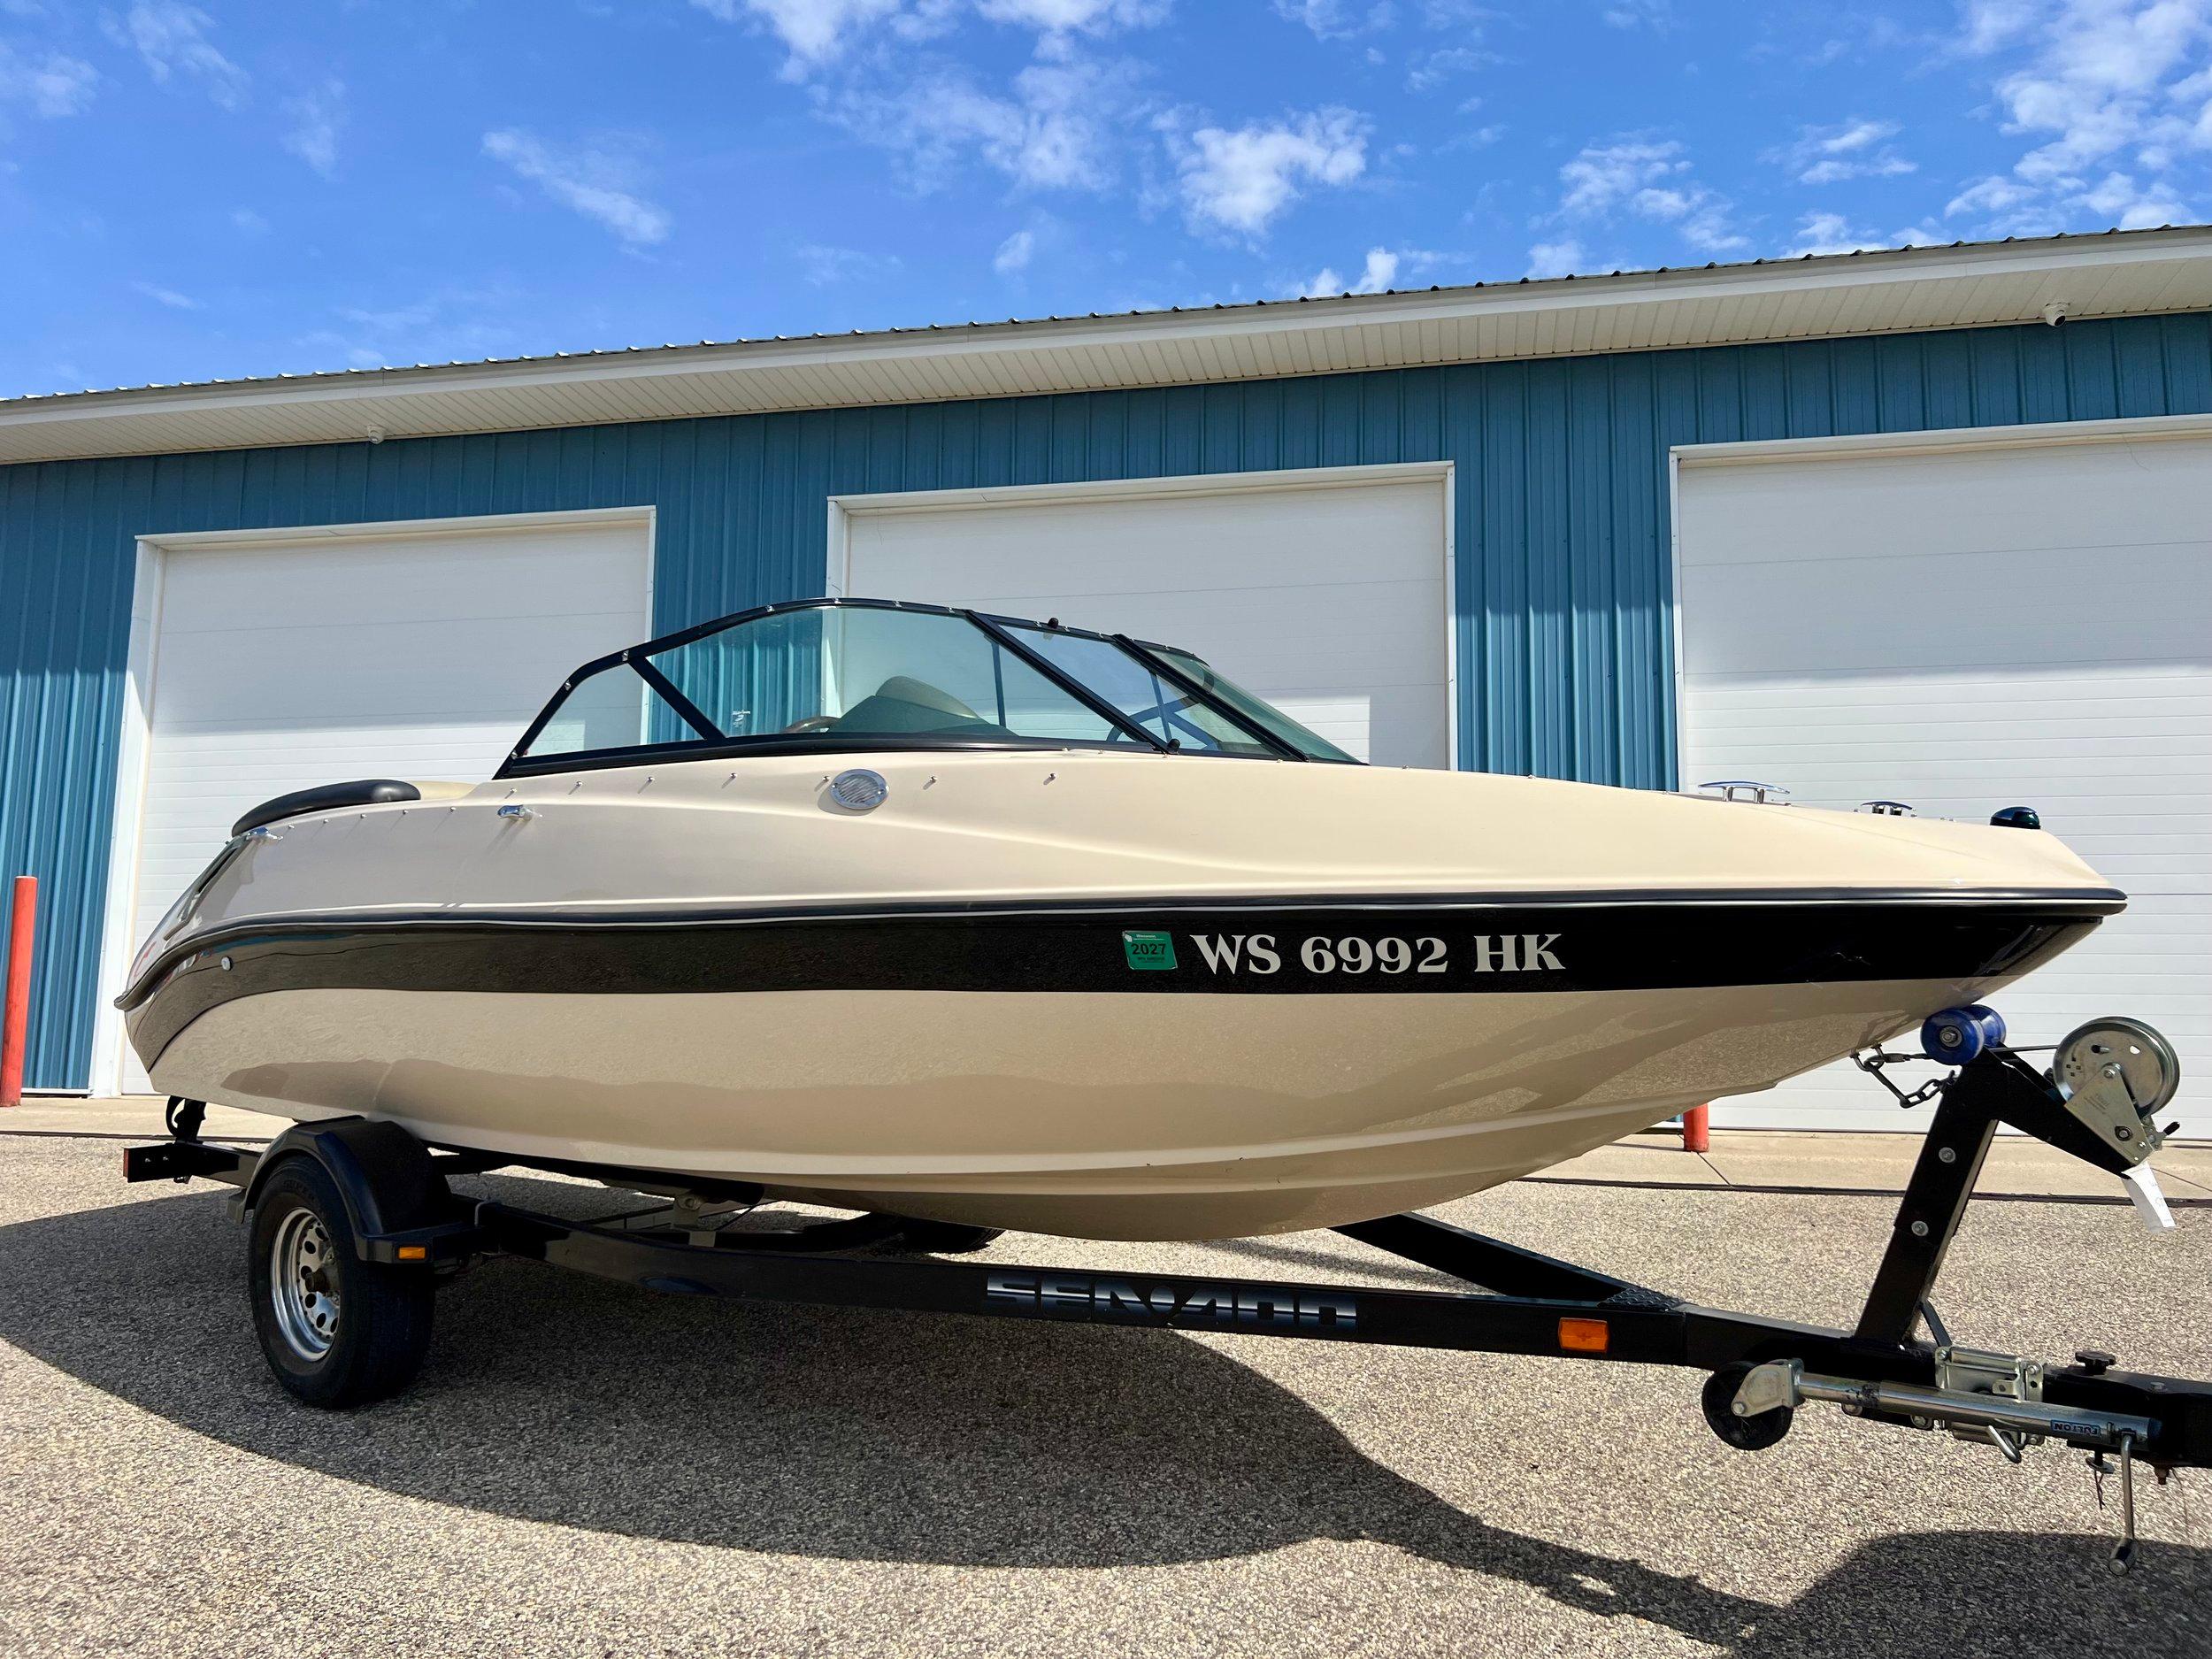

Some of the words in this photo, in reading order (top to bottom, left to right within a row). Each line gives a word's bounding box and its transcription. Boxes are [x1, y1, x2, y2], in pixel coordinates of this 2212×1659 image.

[1131, 943, 1166, 955] 2027
[1190, 933, 1280, 974] WS
[1301, 937, 1448, 973] 6992
[1474, 934, 1565, 972] HK
[2054, 1423, 2098, 1434] FULTON
